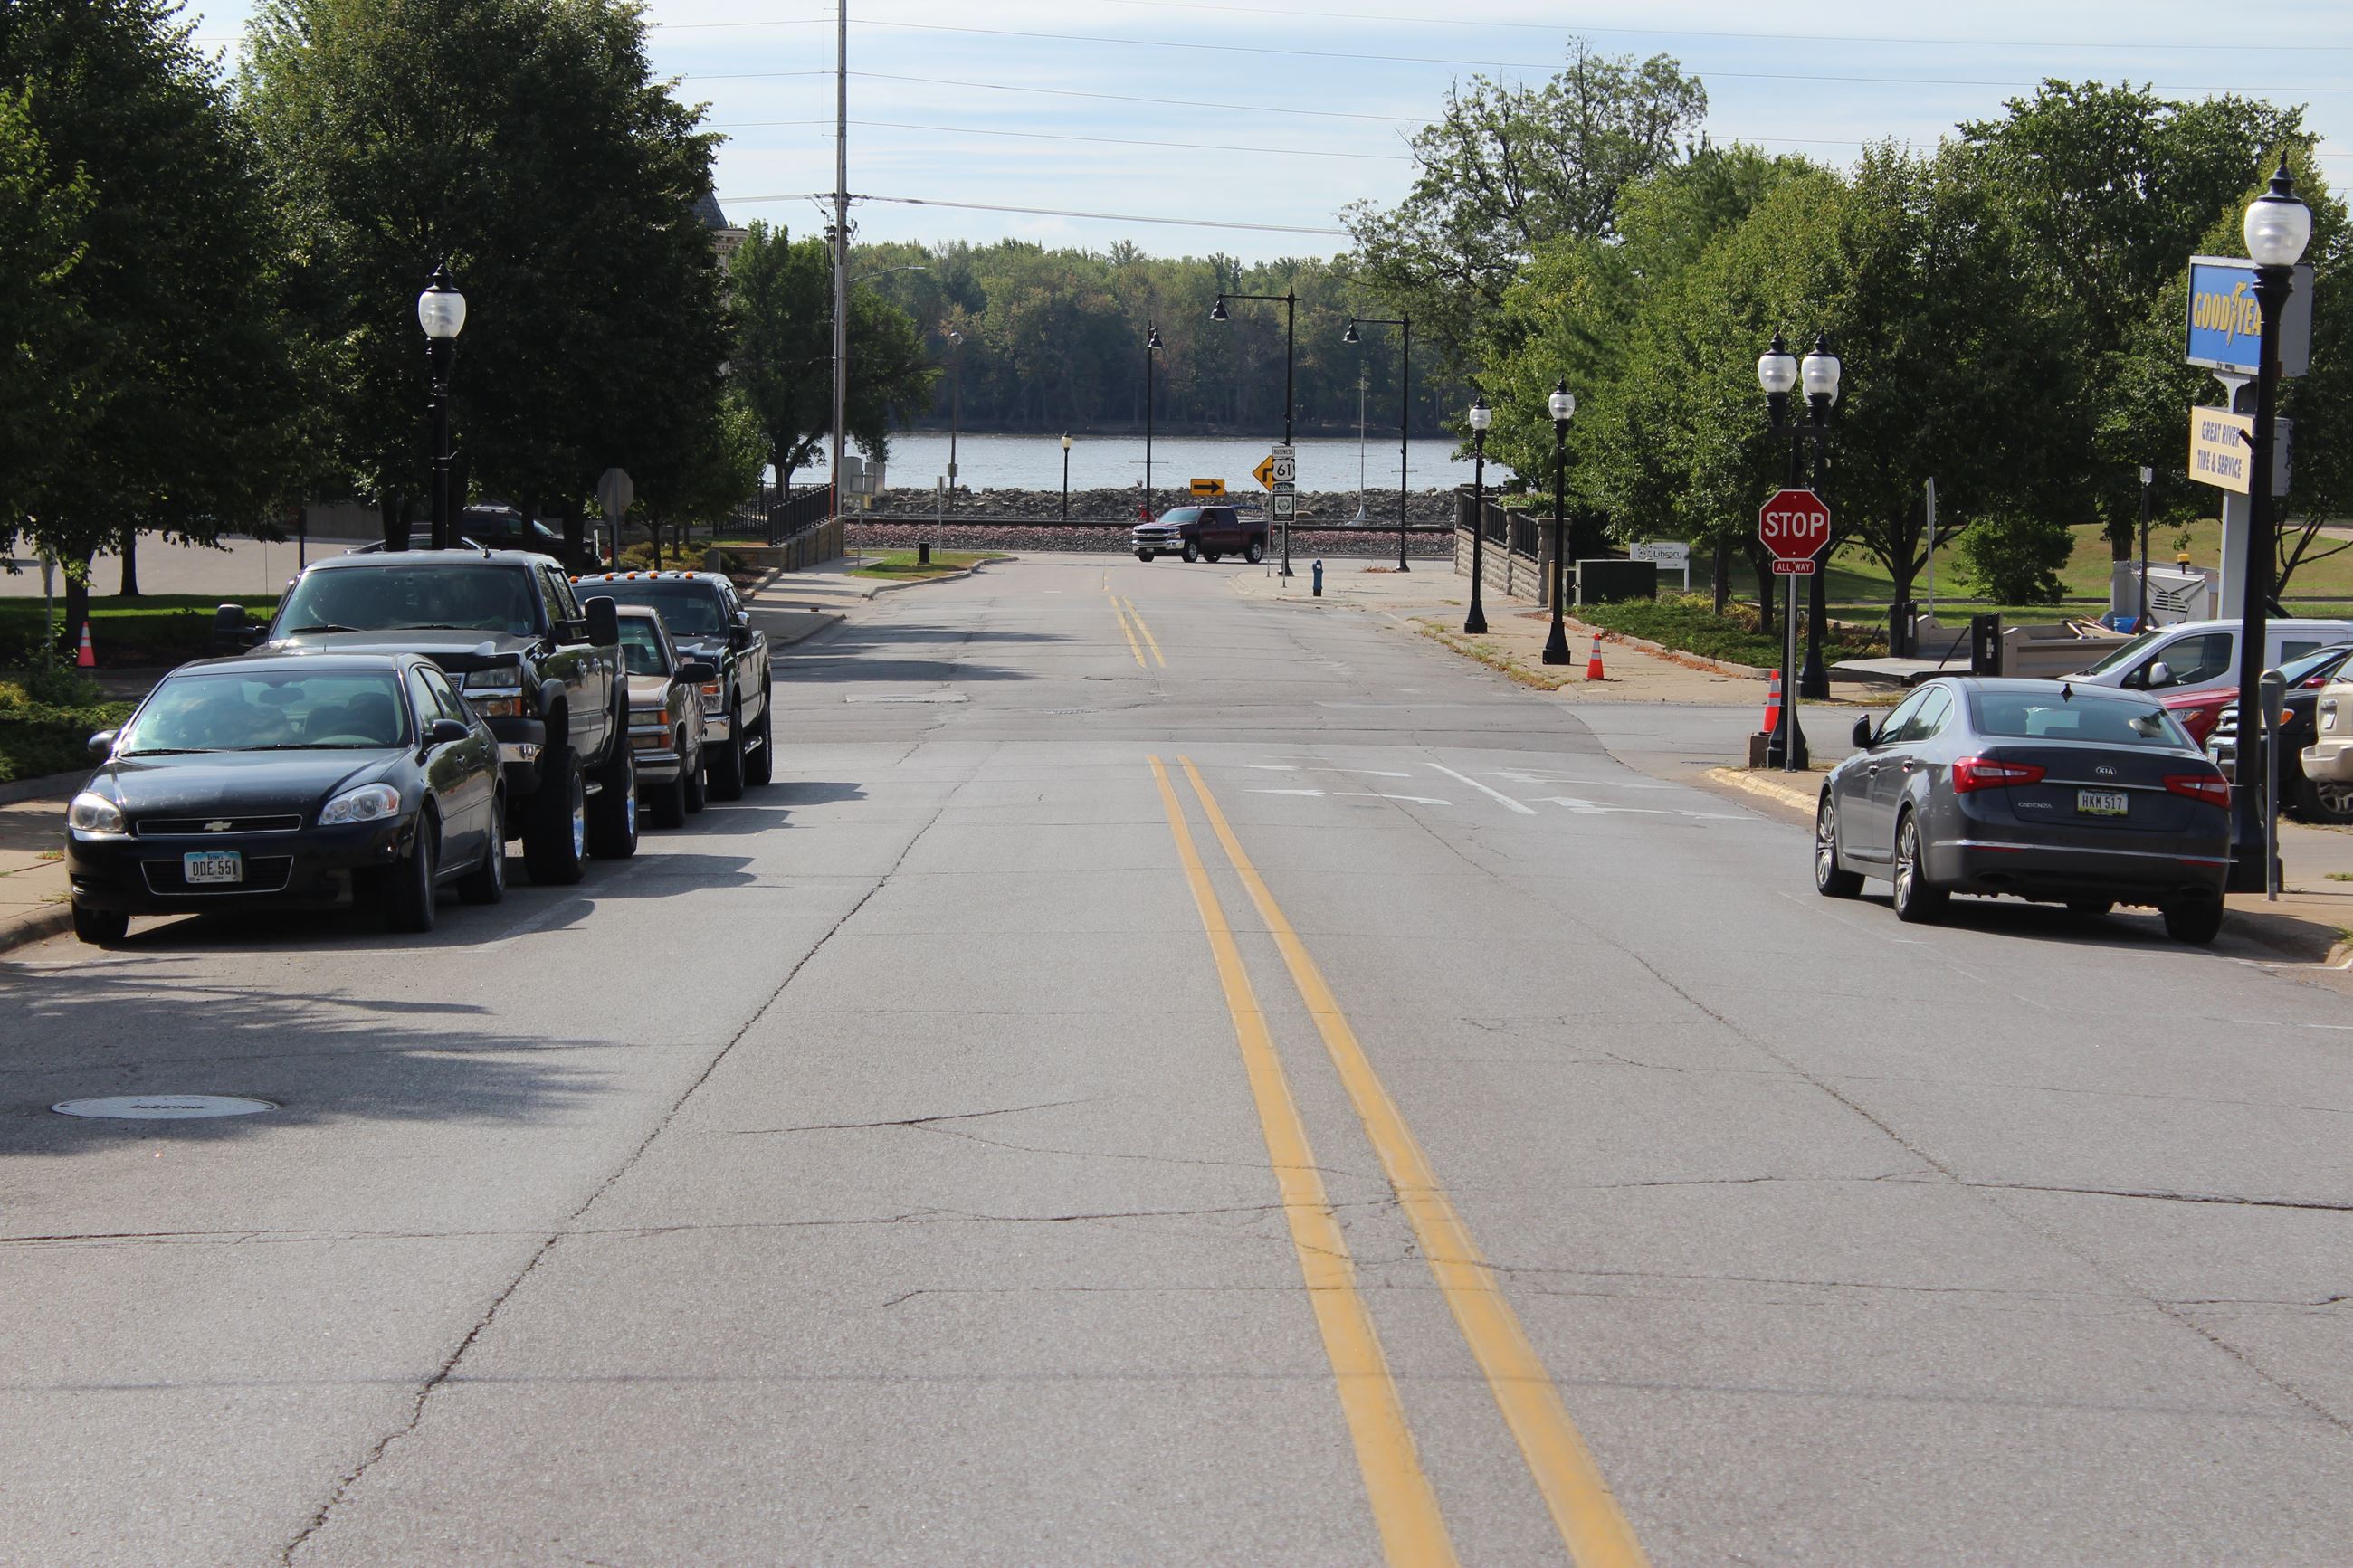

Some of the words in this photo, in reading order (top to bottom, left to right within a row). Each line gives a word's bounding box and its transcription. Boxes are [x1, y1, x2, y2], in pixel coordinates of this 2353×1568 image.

[2193, 291, 2261, 336] GOODYEA
[2202, 420, 2221, 442] GREAT
[2222, 424, 2240, 447] RIVER
[1277, 464, 1291, 476] 61
[2197, 449, 2210, 470] TIRE
[2211, 453, 2216, 472] &
[2217, 454, 2242, 479] SERVICE
[1765, 511, 1824, 537] STOP
[1653, 550, 1682, 559] Library
[1777, 563, 1791, 571] ALL
[1795, 563, 1811, 571] WAY
[2104, 797, 2122, 810] 517
[193, 861, 214, 876] DDE
